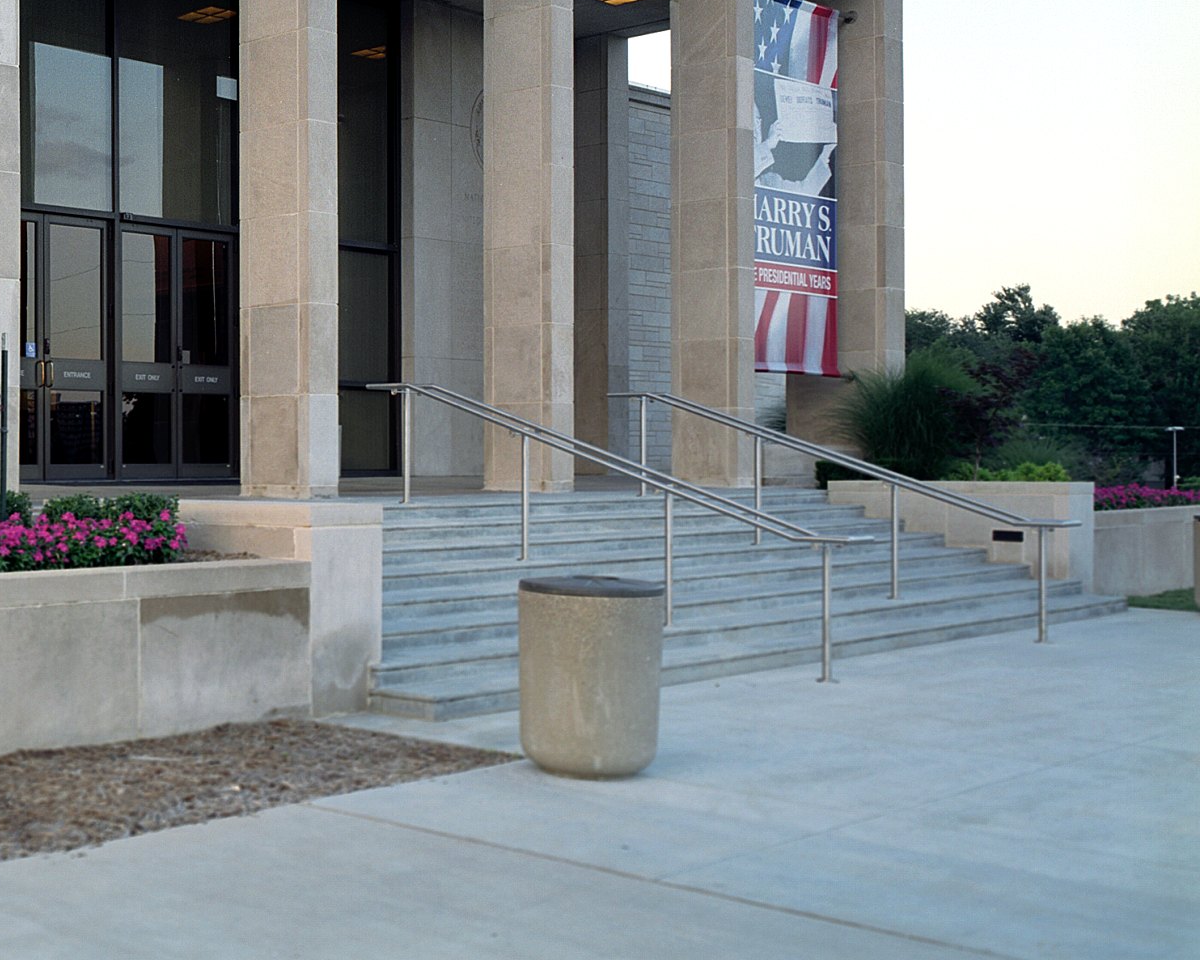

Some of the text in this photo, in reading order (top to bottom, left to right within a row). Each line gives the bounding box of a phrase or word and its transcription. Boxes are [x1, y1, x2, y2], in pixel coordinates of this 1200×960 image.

[818, 205, 832, 232] S.
[754, 224, 831, 263] RUMAN
[758, 267, 808, 288] PRESIDENTIAL
[808, 273, 832, 290] YEARS
[63, 371, 91, 379] ENTRANCE
[135, 373, 147, 381] EXIT
